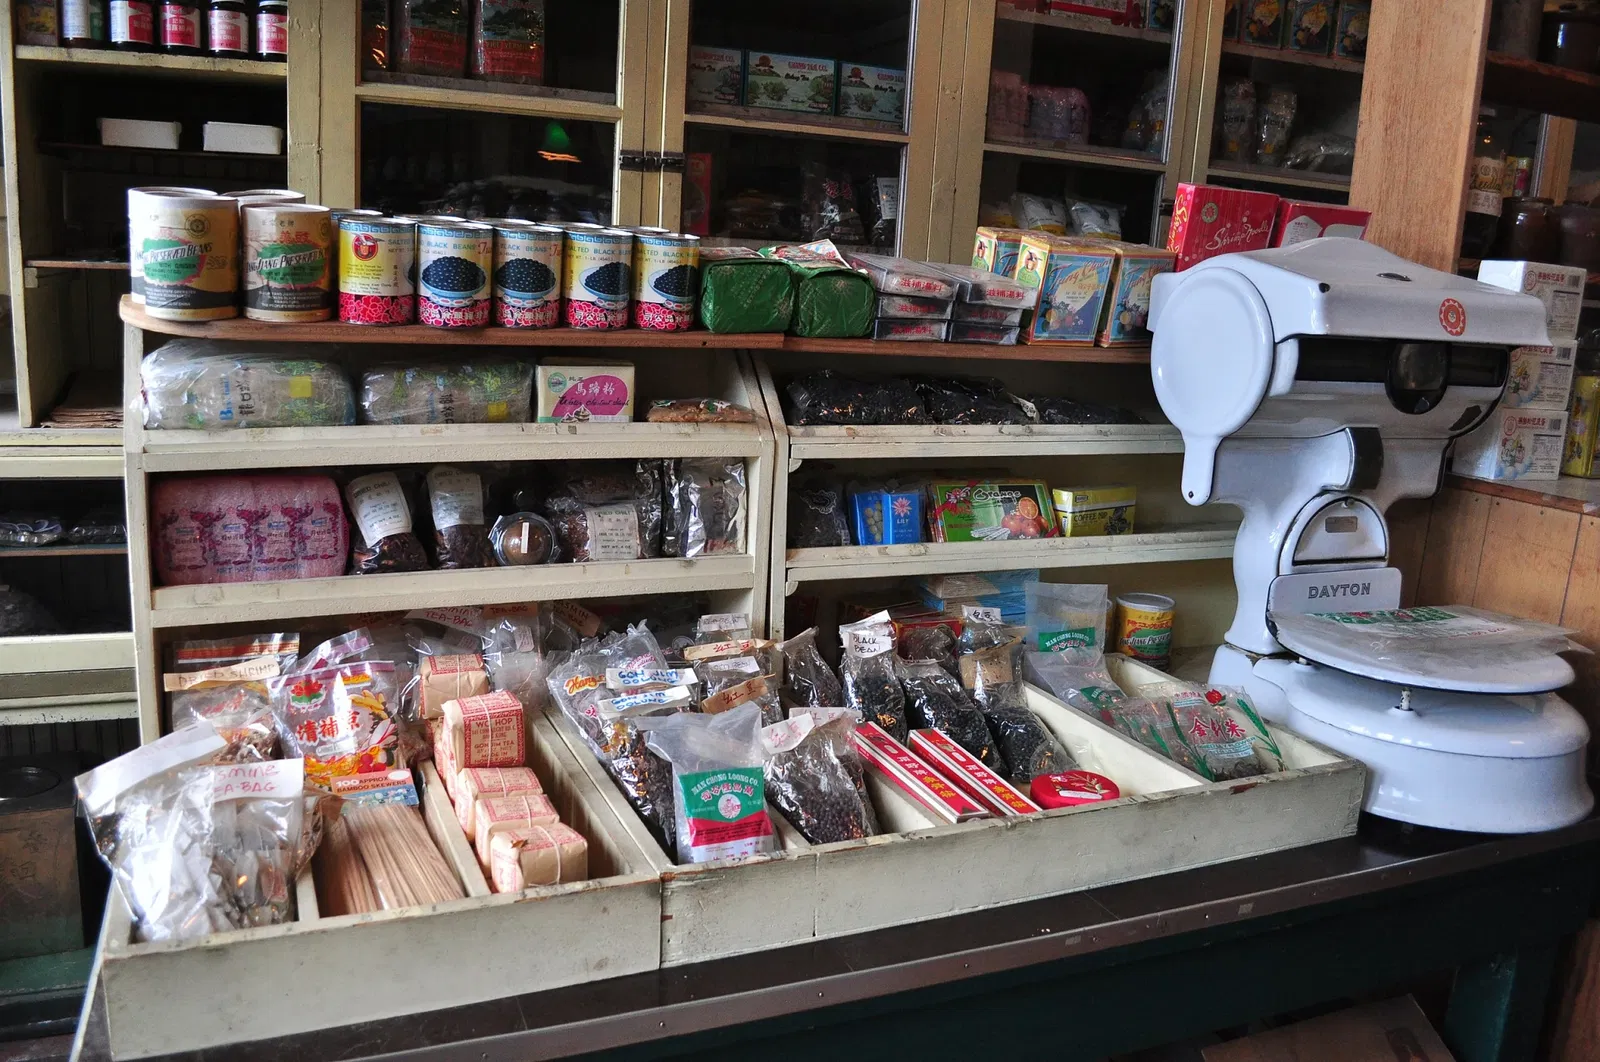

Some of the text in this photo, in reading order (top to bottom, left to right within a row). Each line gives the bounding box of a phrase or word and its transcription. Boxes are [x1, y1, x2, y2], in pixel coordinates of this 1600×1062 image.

[1205, 228, 1246, 250] Shrimp
[1243, 219, 1270, 243] Noodle
[427, 241, 448, 249] BLACK
[594, 247, 615, 255] BLACK
[1049, 262, 1080, 291] Tung
[575, 381, 615, 396] 馬蹄粉
[973, 488, 1022, 503] Orange
[1074, 513, 1097, 523] COFFEE
[1308, 582, 1371, 599] DAYTON
[490, 605, 528, 613] TEA-BAG
[424, 611, 473, 627] TEA-BAG
[852, 634, 879, 645] BLACK
[853, 645, 879, 654] BEAN
[229, 663, 275, 677] SHRIMP
[495, 718, 512, 726] HOP
[336, 776, 389, 788] 100 APPROX
[336, 780, 407, 793] BAMBOO SKEWERS
[690, 772, 760, 796] MAN CHONG LOONG CO.
